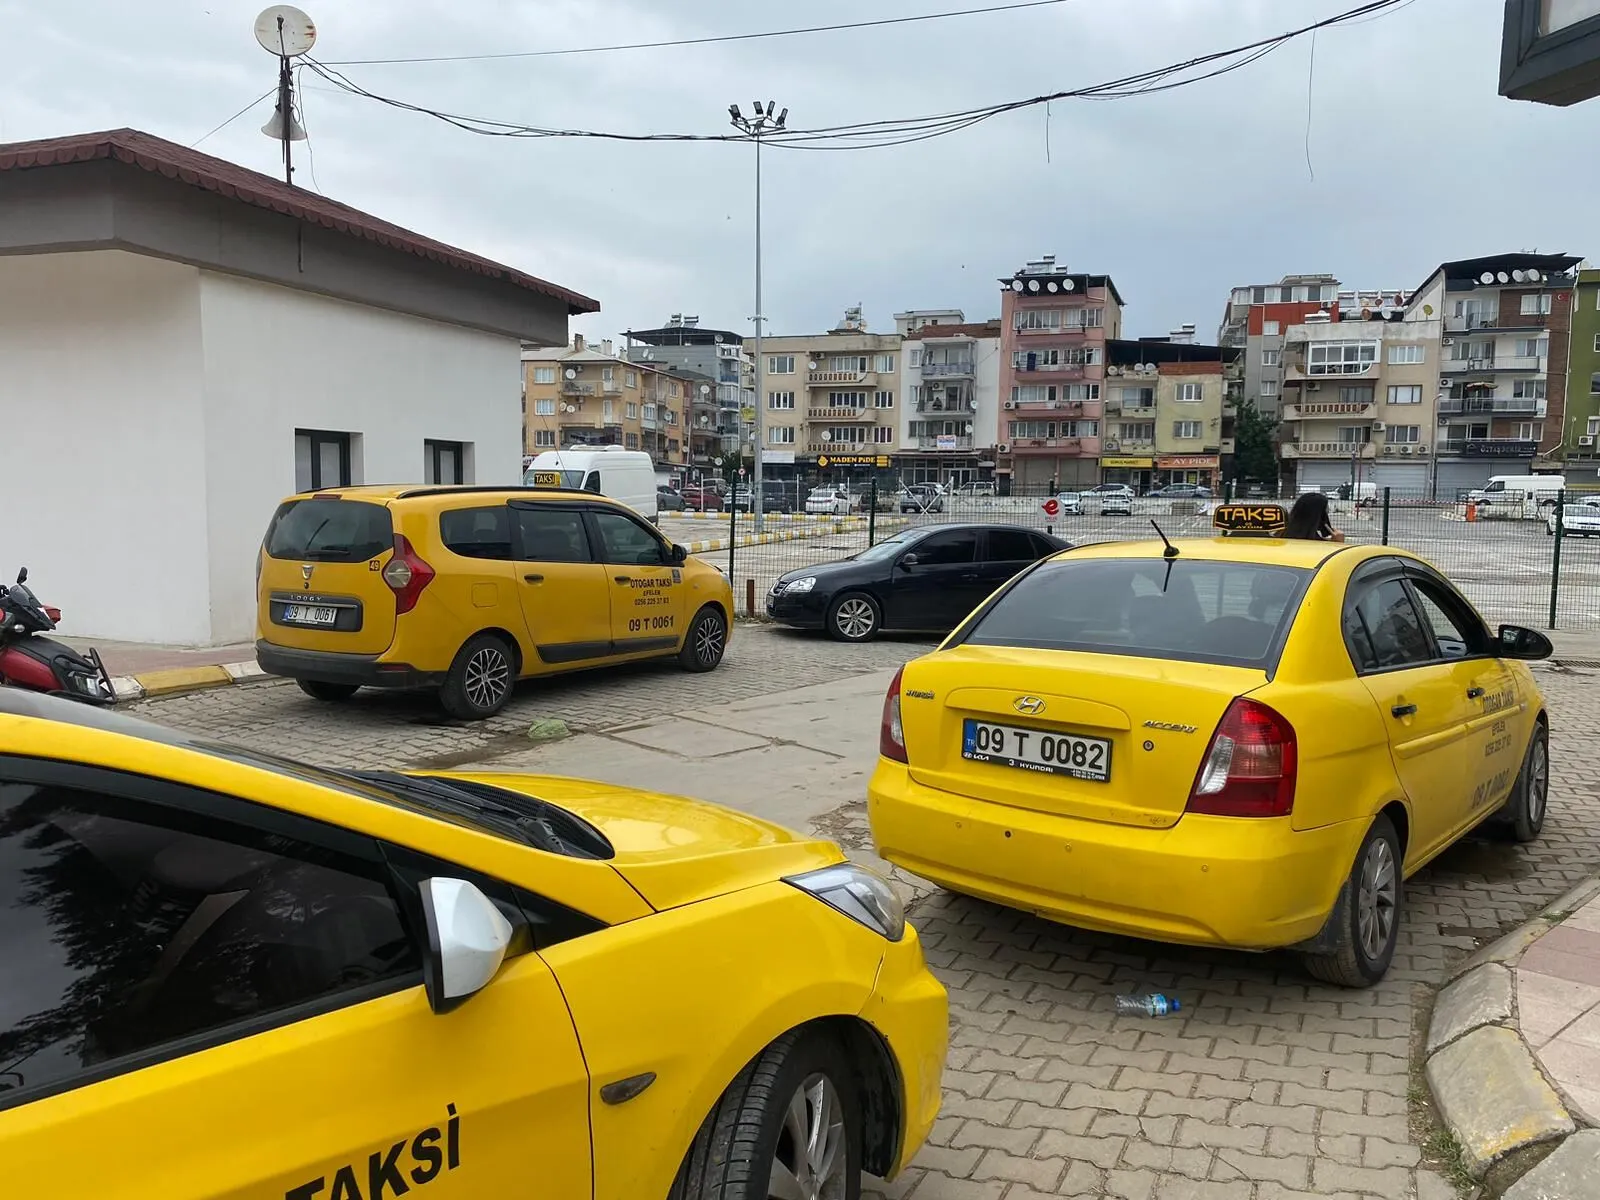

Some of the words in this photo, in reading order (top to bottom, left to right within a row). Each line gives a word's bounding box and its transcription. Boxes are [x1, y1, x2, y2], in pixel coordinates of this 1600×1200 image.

[370, 561, 379, 570] 49
[630, 578, 655, 588] OTOGAR
[289, 604, 299, 619] 09
[304, 606, 310, 619] T
[314, 608, 335, 622] 0061
[629, 618, 641, 632] 09
[644, 618, 650, 630] T
[652, 615, 674, 629] 0061
[976, 726, 1004, 754] 09
[1014, 732, 1030, 757] T
[1040, 736, 1104, 770] 0082
[1020, 762, 1054, 773] HYUNDAI
